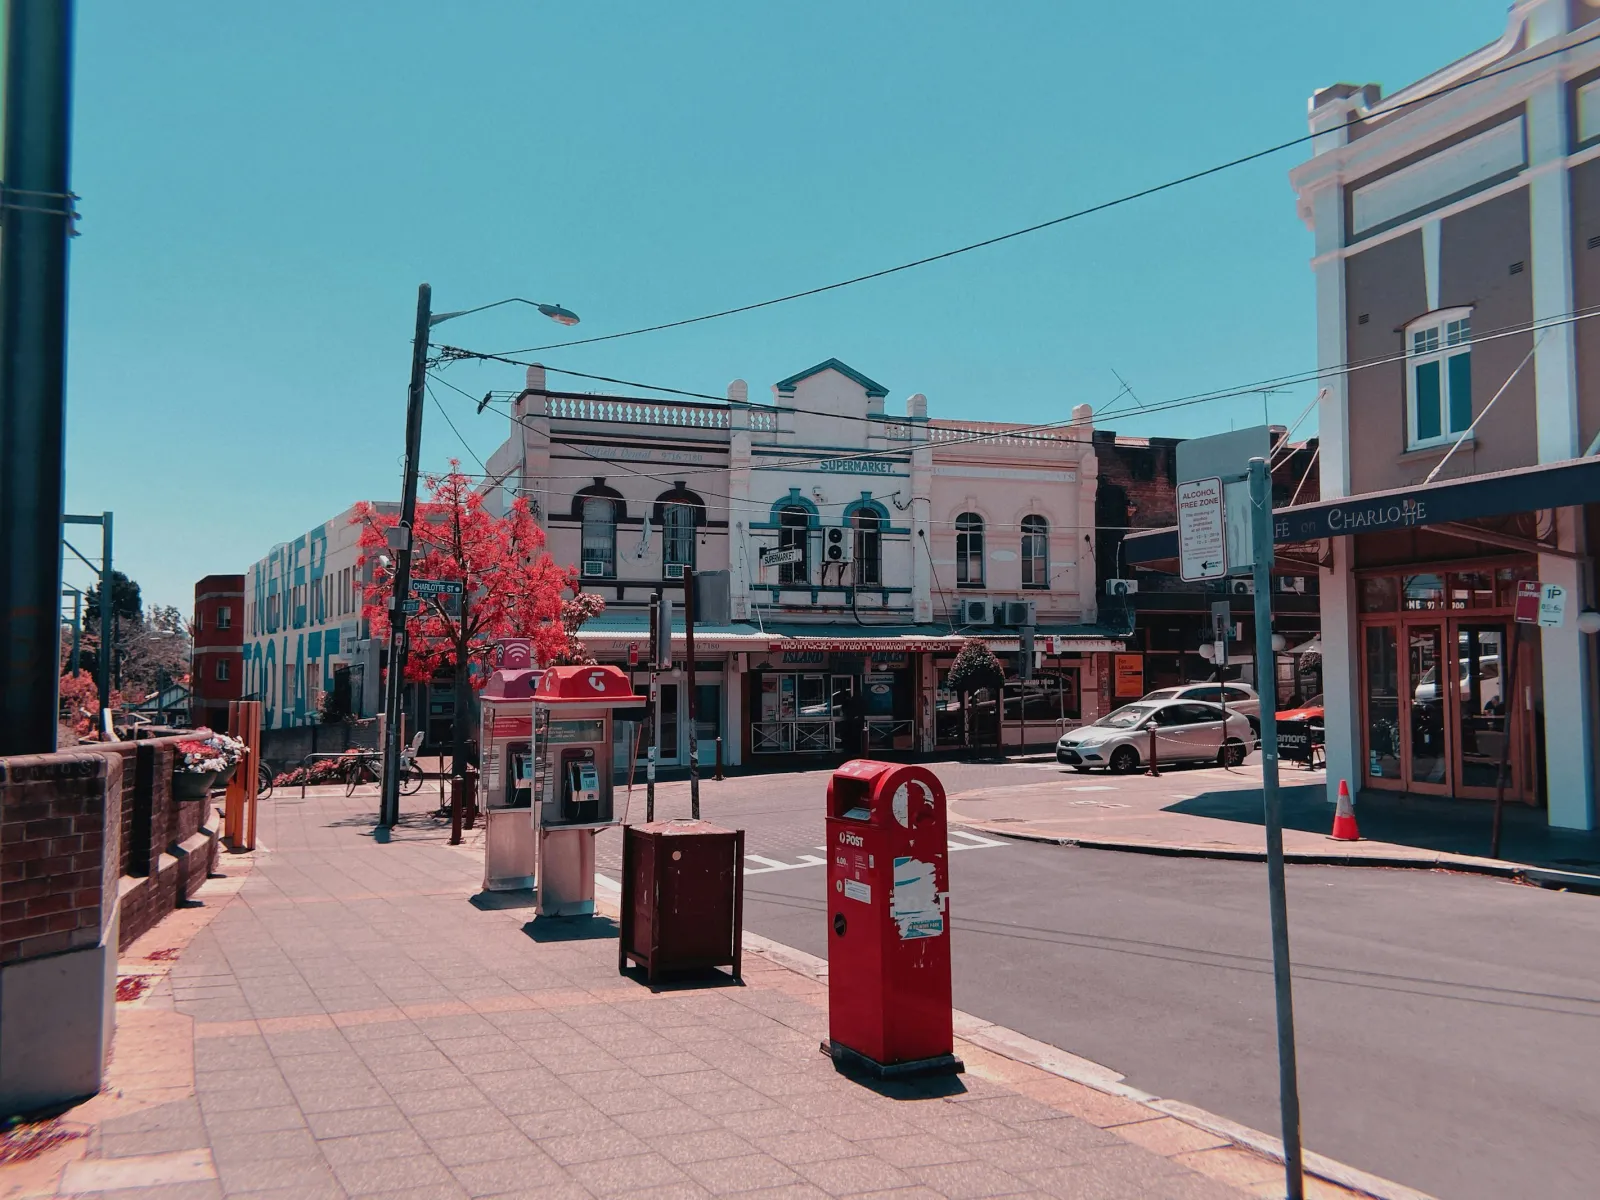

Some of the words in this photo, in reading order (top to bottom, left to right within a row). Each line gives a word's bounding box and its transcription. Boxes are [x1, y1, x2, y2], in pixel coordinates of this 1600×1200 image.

[1182, 488, 1215, 500] ALCOHOL
[1180, 501, 1198, 509] FREE
[1199, 497, 1219, 506] ZONE
[764, 551, 795, 565] SUPERMARKET
[254, 525, 328, 636] NEVER
[413, 582, 445, 592] CHARLOTTE
[1525, 583, 1535, 591] NO
[1546, 589, 1562, 599] 1P
[242, 637, 277, 730] TOO
[281, 627, 340, 729] LATE
[845, 834, 864, 848] POST
